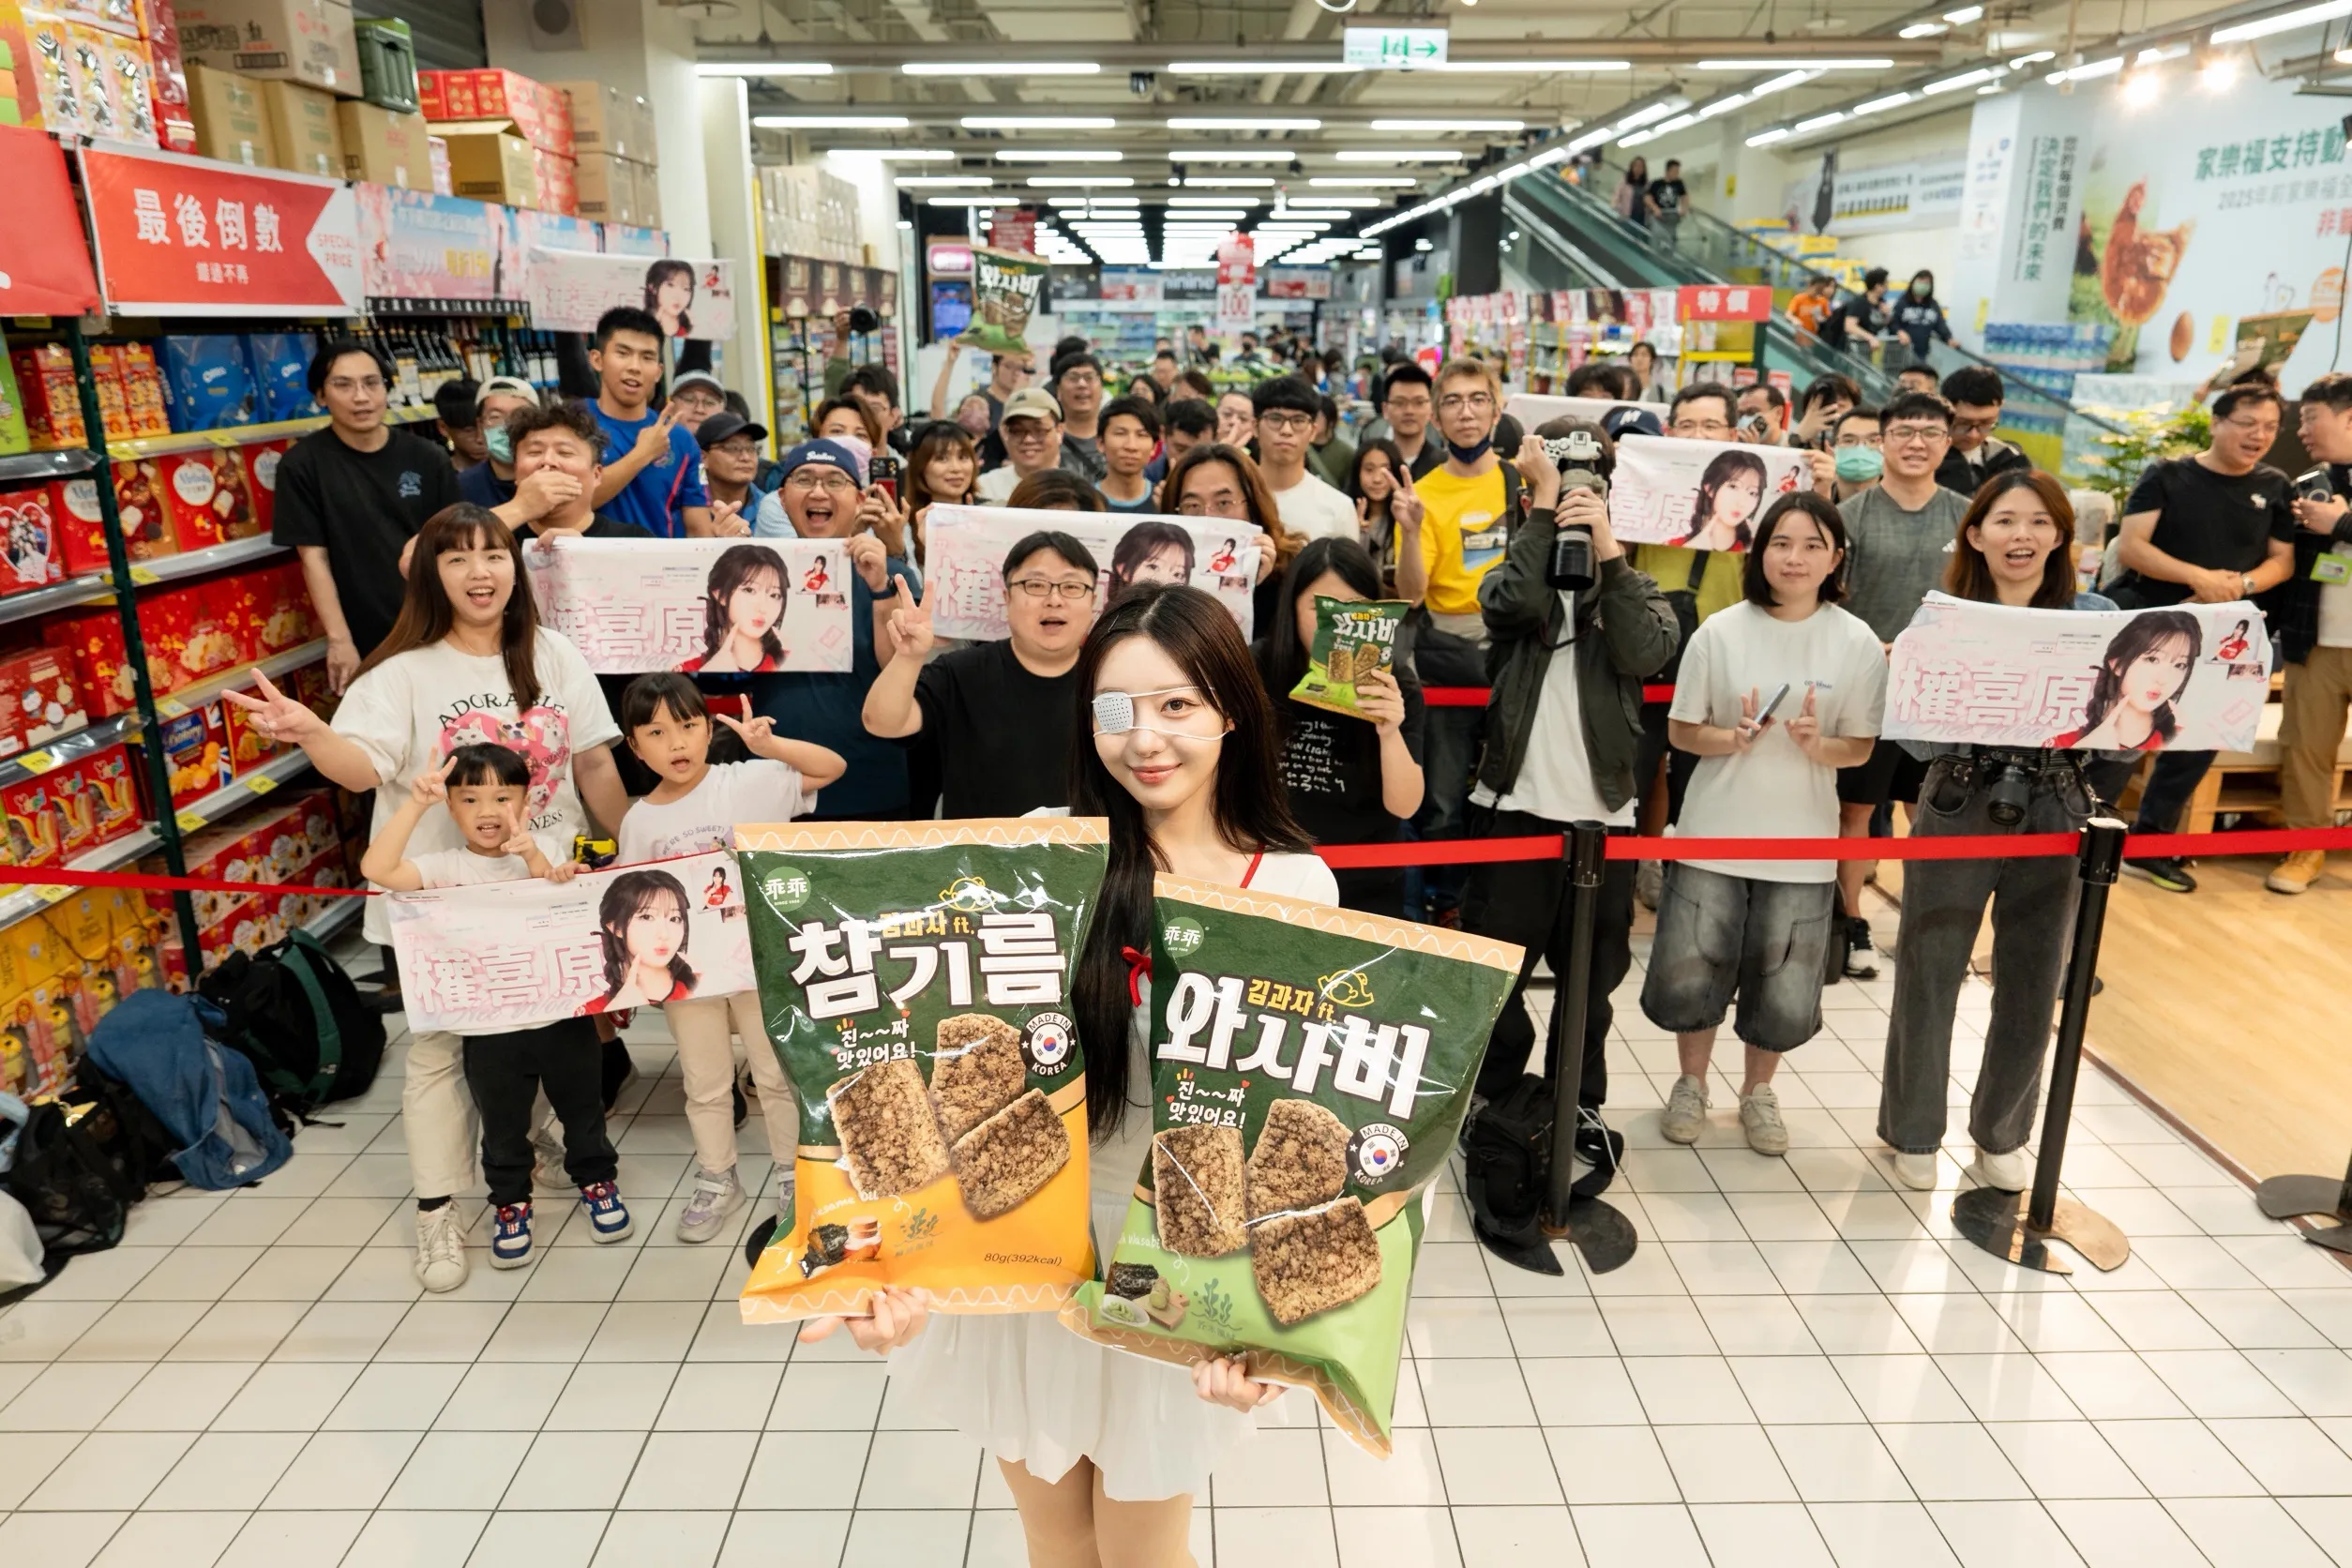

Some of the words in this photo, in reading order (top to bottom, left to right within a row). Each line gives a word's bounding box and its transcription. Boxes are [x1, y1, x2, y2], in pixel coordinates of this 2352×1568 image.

[133, 188, 283, 253] 最後倒數
[324, 251, 354, 268] PRICE
[1697, 290, 1750, 313] 特價
[1895, 657, 2101, 729] 權喜原
[528, 809, 564, 831] NESS
[764, 877, 808, 901] 乖乖
[953, 915, 975, 936] ft.
[1164, 926, 1201, 947] 乖乖
[411, 936, 611, 1017] 權喜原
[788, 912, 1066, 1020] 참기름
[1247, 978, 1315, 1017] 김과자
[1317, 1002, 1337, 1024] ft.
[1028, 1014, 1058, 1032] MADE
[1060, 1017, 1071, 1031] IN
[837, 1041, 916, 1071] 맛있어요!
[1156, 972, 1430, 1121] 와사비
[1032, 1062, 1067, 1076] KOREA
[1168, 1102, 1246, 1129] 맛있어요!
[1362, 1125, 1395, 1138] MADE
[1396, 1135, 1408, 1150] IN
[1354, 1168, 1383, 1186] KOREA
[984, 1252, 1063, 1267] 80g(392kcal)
